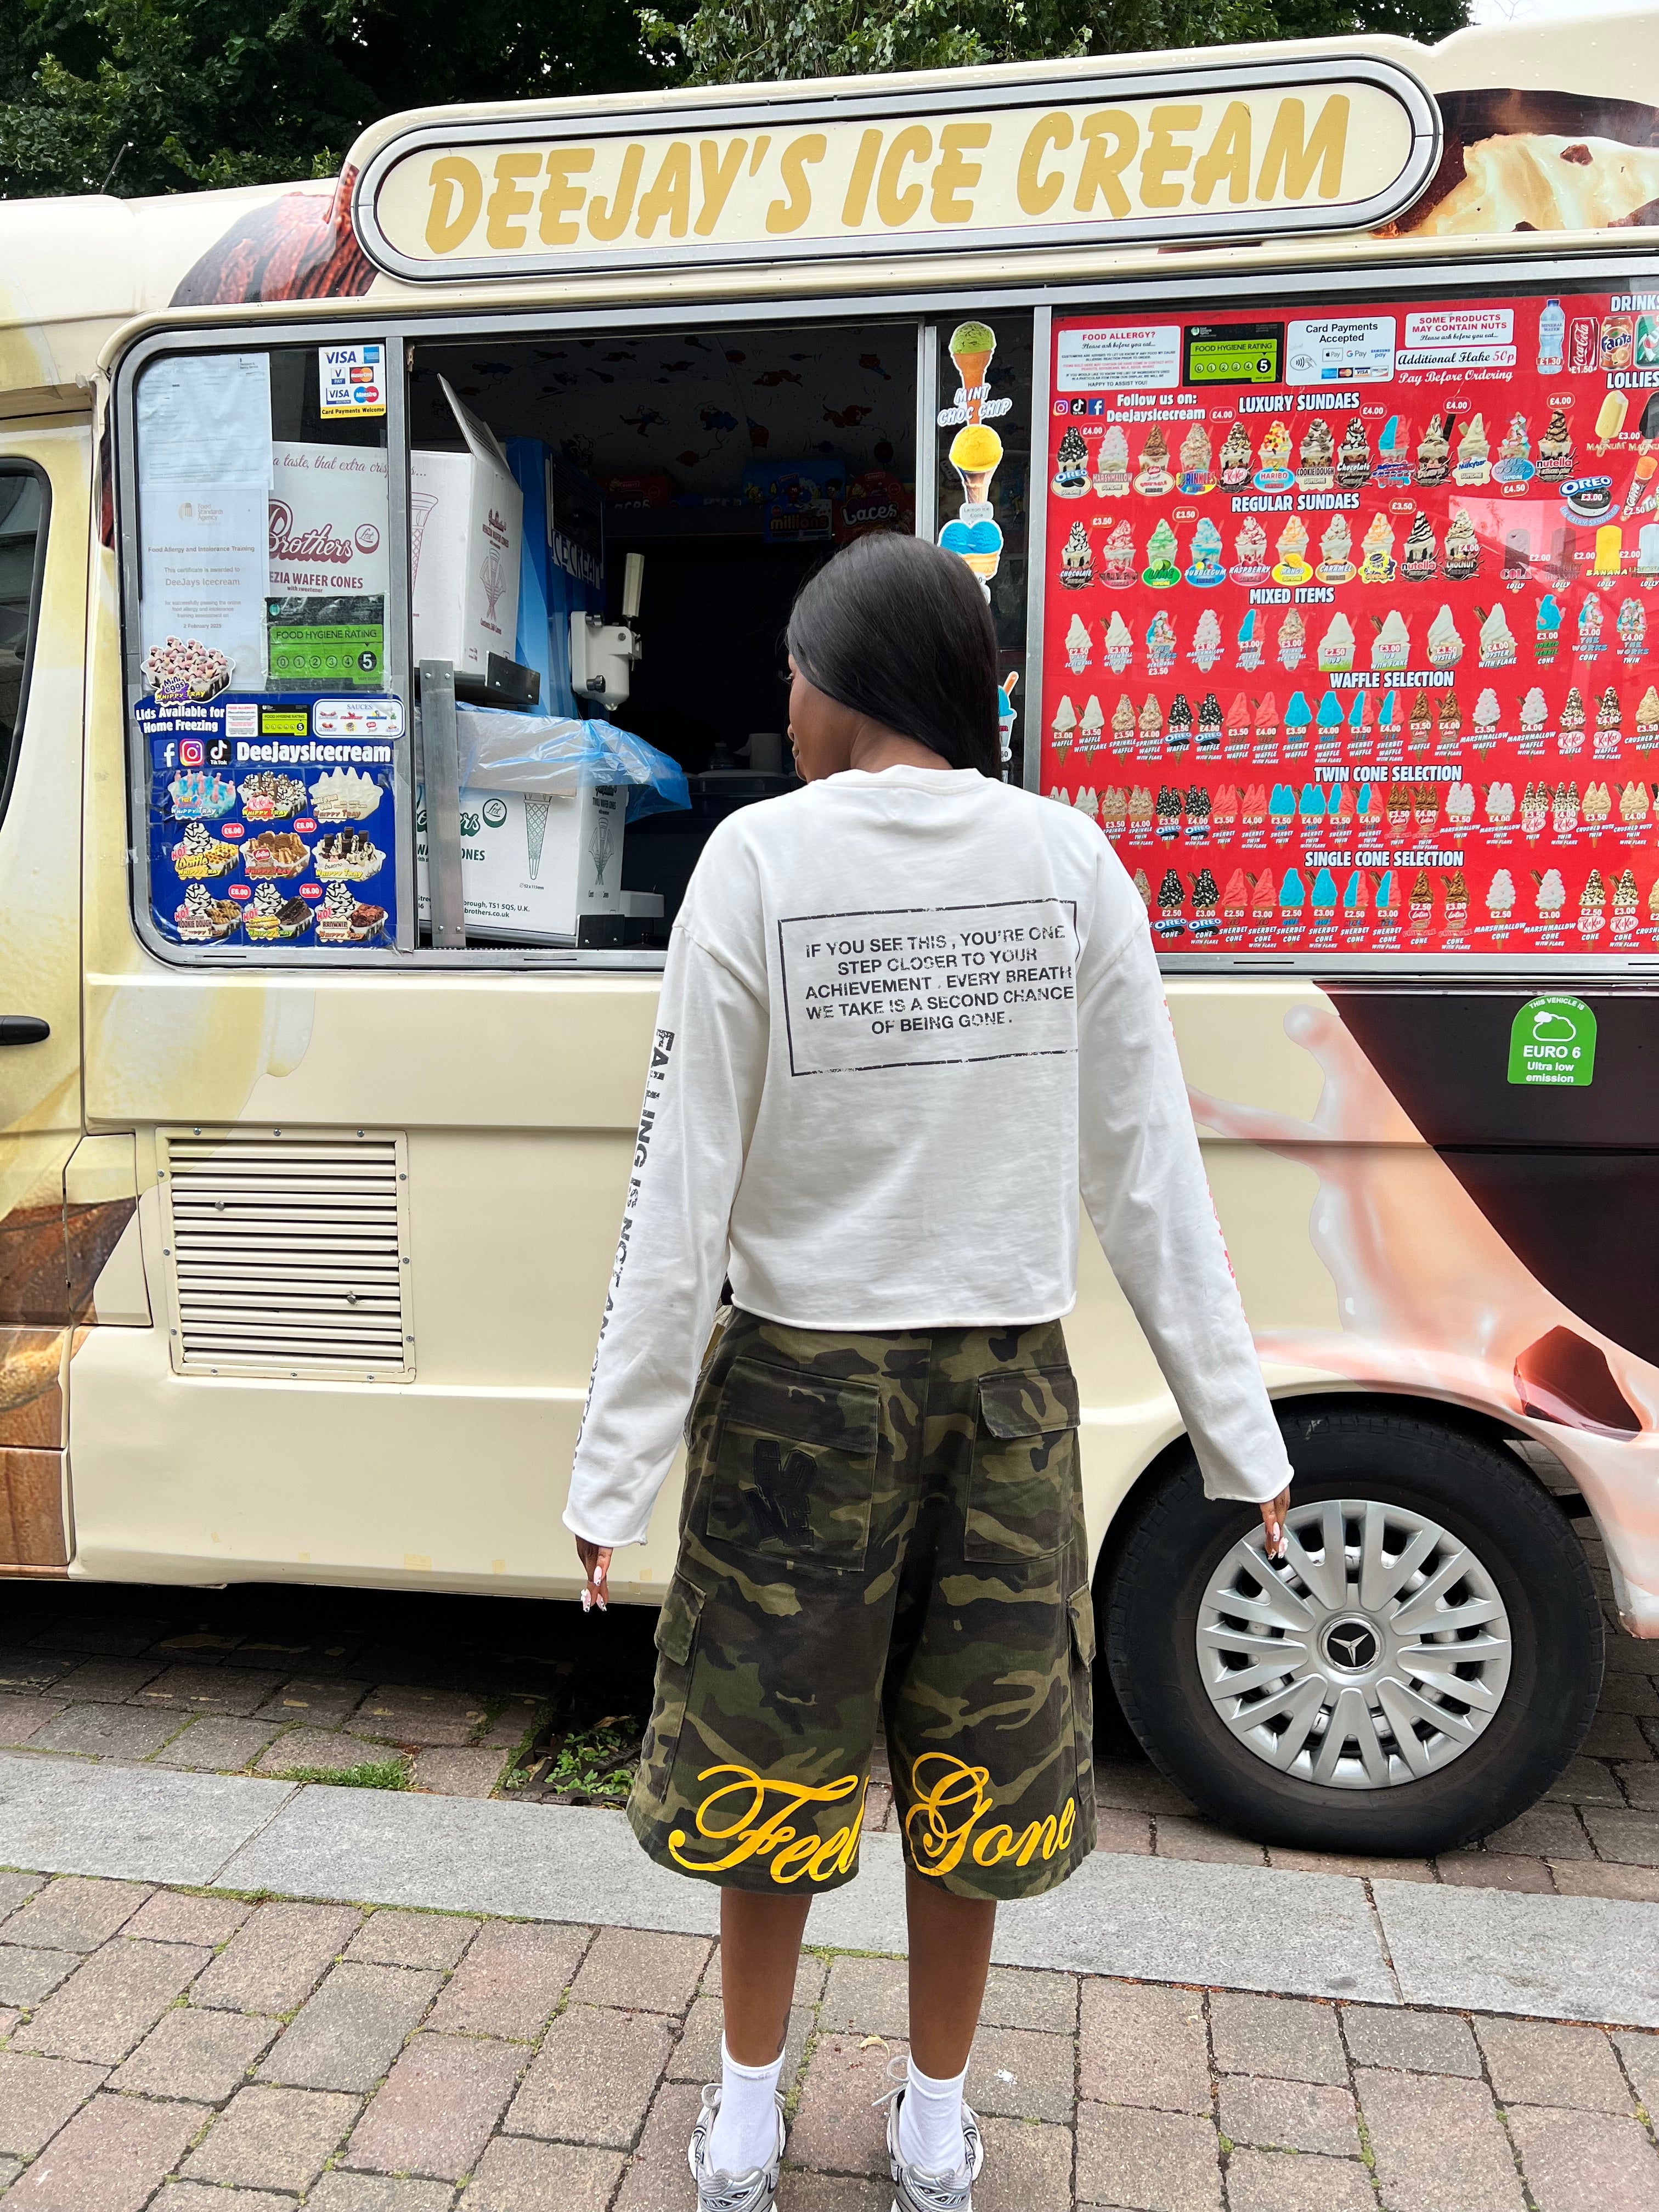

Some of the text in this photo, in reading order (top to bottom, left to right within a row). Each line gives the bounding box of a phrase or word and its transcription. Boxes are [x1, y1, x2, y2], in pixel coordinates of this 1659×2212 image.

[425, 94, 1351, 254] DEEJAY'S ICE CREAM
[1449, 314, 1500, 323] PRODUCTS
[1306, 323, 1378, 333] Card Payments
[1319, 333, 1364, 343] Accepted
[1602, 332, 1632, 351] Fanta
[326, 351, 357, 364] VISA
[1398, 351, 1515, 364] Additional Flake 50p
[1260, 360, 1268, 371] 5
[1398, 370, 1513, 386] Pay Before Ordering
[1607, 372, 1659, 388] LOLLIES
[330, 389, 349, 398] VISA
[956, 385, 989, 403] MINT
[1117, 393, 1198, 407] Follow us on:
[1238, 392, 1360, 413] LUXURY SUNDAES
[938, 399, 1011, 424] CHOC CHIP
[1107, 408, 1205, 422] Deejaysicecream
[284, 454, 309, 469] taste,
[314, 455, 337, 470] that
[339, 458, 365, 472] extra
[1336, 463, 1370, 471] Chocolate
[1536, 459, 1572, 467] nutella
[1504, 484, 1525, 493] £4.50
[1562, 477, 1611, 494] OREO
[1231, 493, 1359, 512] REGULAR SUNDAES
[844, 501, 898, 528] Laces
[770, 516, 827, 531] millions
[292, 573, 328, 586] WAFER
[330, 576, 363, 589] CONES
[1149, 569, 1173, 579] LIME
[1500, 569, 1532, 580] COLA
[166, 579, 200, 587] DeeJays
[1250, 587, 1334, 604] MIXED ITEMS
[306, 630, 343, 639] HYGIENE
[345, 630, 377, 638] RATING
[363, 653, 373, 670] 5
[164, 675, 181, 686] Mini
[165, 681, 185, 693] eggs
[1330, 671, 1455, 688] WAFFLE SELECTION
[136, 707, 225, 721] Lids Available for
[143, 721, 173, 733] Home
[175, 719, 218, 732] Freezing
[236, 741, 391, 763] Deejaysicecream
[1314, 766, 1462, 782] TWIN CONE SELECTION
[171, 845, 187, 860] HOT
[1305, 851, 1464, 867] SINGLE CONE SELECTION
[1490, 910, 1511, 919] £2.50
[1154, 918, 1187, 929] OREO
[1474, 923, 1526, 933] MARSHMALLOW
[806, 944, 821, 958] IF
[826, 941, 865, 956] YOU
[870, 938, 903, 952] SEE
[960, 929, 1024, 946] YOU'RE
[1029, 925, 1065, 940] ONE
[838, 947, 1037, 975] STEP CLOSER TO YOUR
[946, 970, 1001, 988] EVERY
[1006, 966, 1073, 984] BREATH
[806, 985, 1074, 1020] WE TAKE IS A SECOND CHANCE
[1528, 999, 1545, 1009] THIS
[1547, 997, 1577, 1006] VEHICLE
[871, 1020, 896, 1035] OF
[900, 1017, 954, 1032] BEING
[1523, 1045, 1581, 1058] EURO 6
[1527, 1062, 1574, 1071] Ultra low
[1526, 1074, 1574, 1082] emission
[634, 1029, 675, 1168] FALLING
[627, 1177, 641, 1208] IS
[668, 1752, 1076, 1884] Feel Gone
